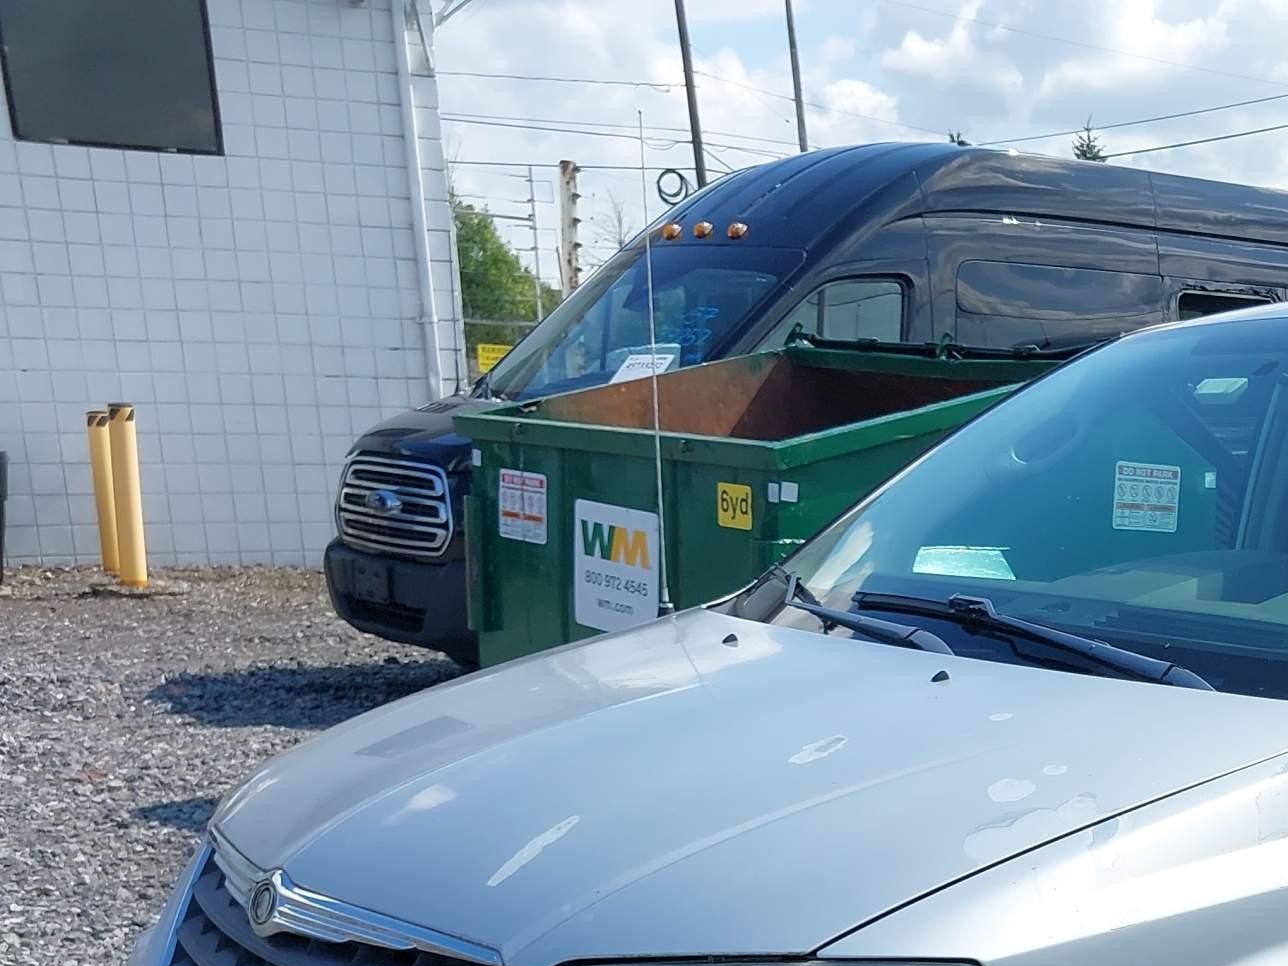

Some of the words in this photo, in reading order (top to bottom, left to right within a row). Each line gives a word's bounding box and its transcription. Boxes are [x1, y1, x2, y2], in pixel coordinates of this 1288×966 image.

[720, 490, 749, 520] 6yd
[580, 519, 650, 569] WM
[584, 570, 602, 586] 800
[604, 574, 621, 591] 972
[623, 579, 648, 597] 4545
